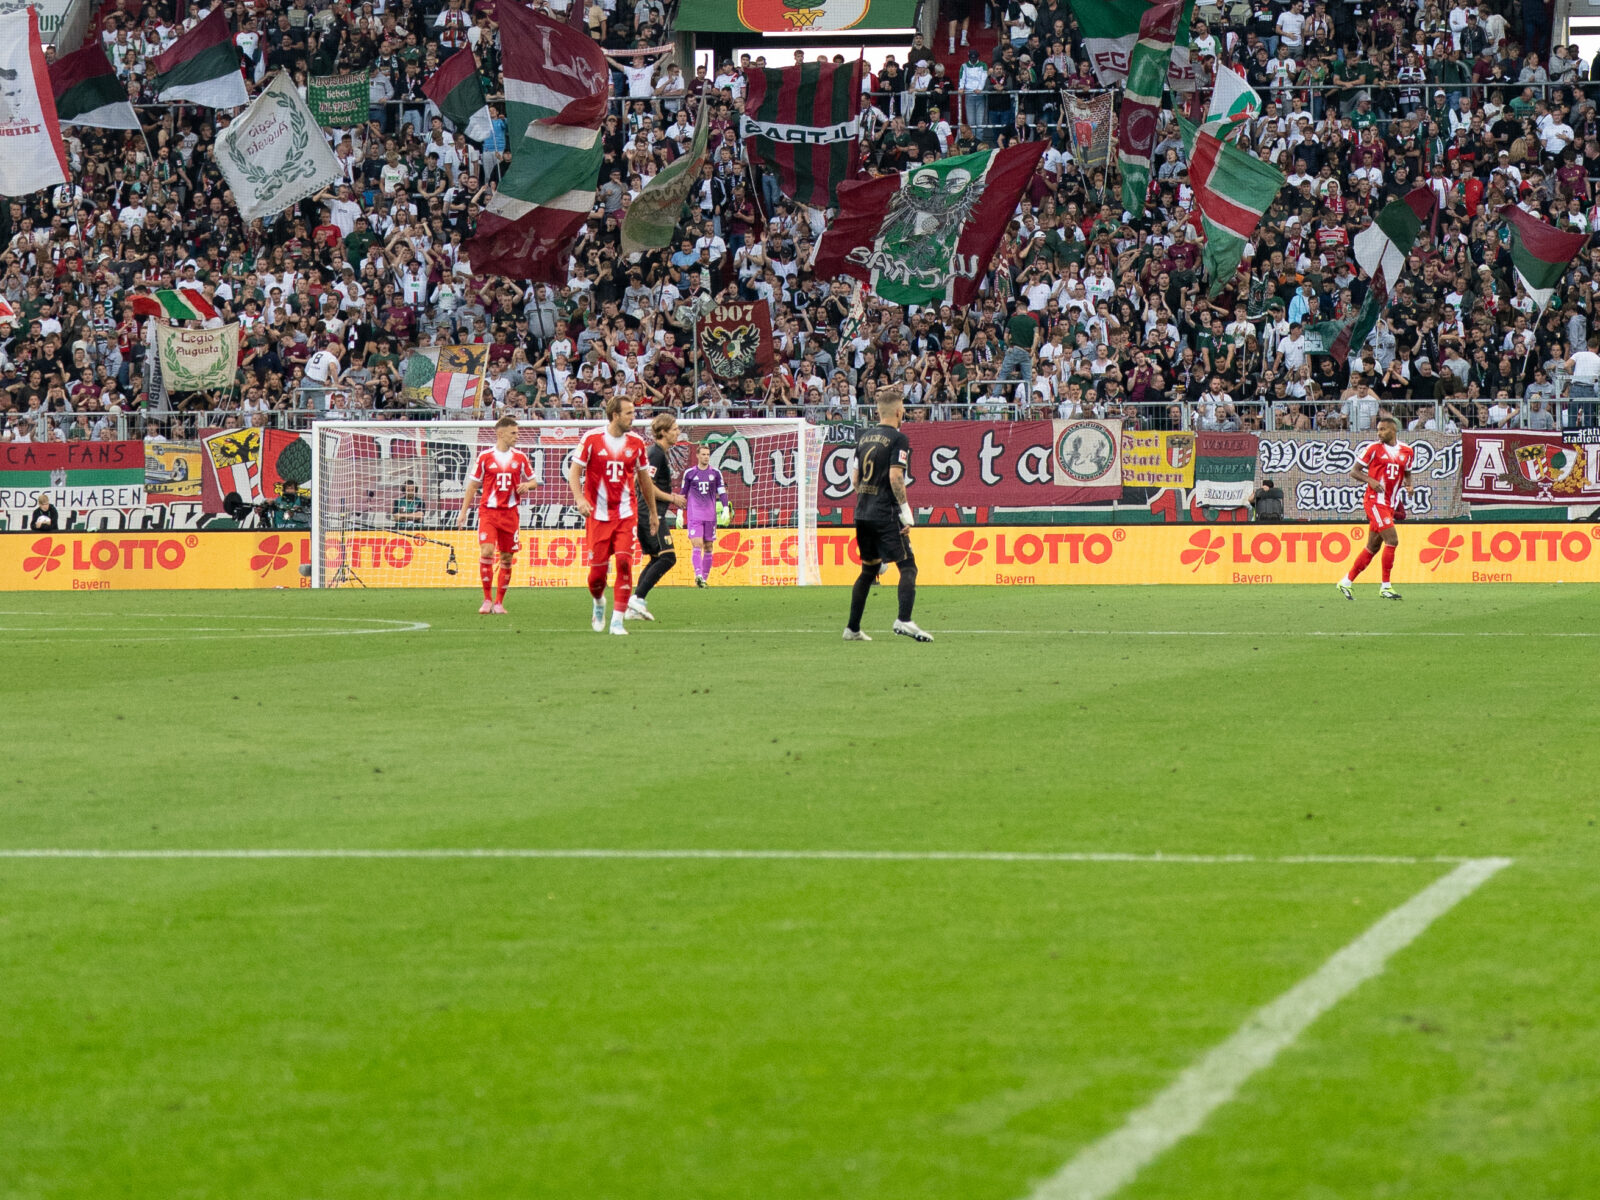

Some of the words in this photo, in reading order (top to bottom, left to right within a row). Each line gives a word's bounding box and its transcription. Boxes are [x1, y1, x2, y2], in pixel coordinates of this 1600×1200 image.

[704, 304, 754, 324] 1907
[181, 332, 214, 345] Legio
[176, 346, 219, 357] Augusta
[1121, 434, 1159, 450] Frei
[68, 444, 126, 463] FANS
[703, 430, 1053, 500] Augsta
[863, 445, 876, 482] 6
[1121, 469, 1183, 484] Bayern
[1296, 481, 1433, 514] Augsg
[73, 539, 186, 570] LOTTO
[996, 533, 1113, 564] LOTTO
[1233, 531, 1351, 563] LOTTO
[1472, 531, 1592, 562] LOTTO
[72, 578, 111, 590] Bayern
[529, 576, 568, 588] Bayern
[995, 573, 1036, 585] Bayern
[1232, 572, 1273, 584] Bayern
[1472, 571, 1513, 583] Bayern
